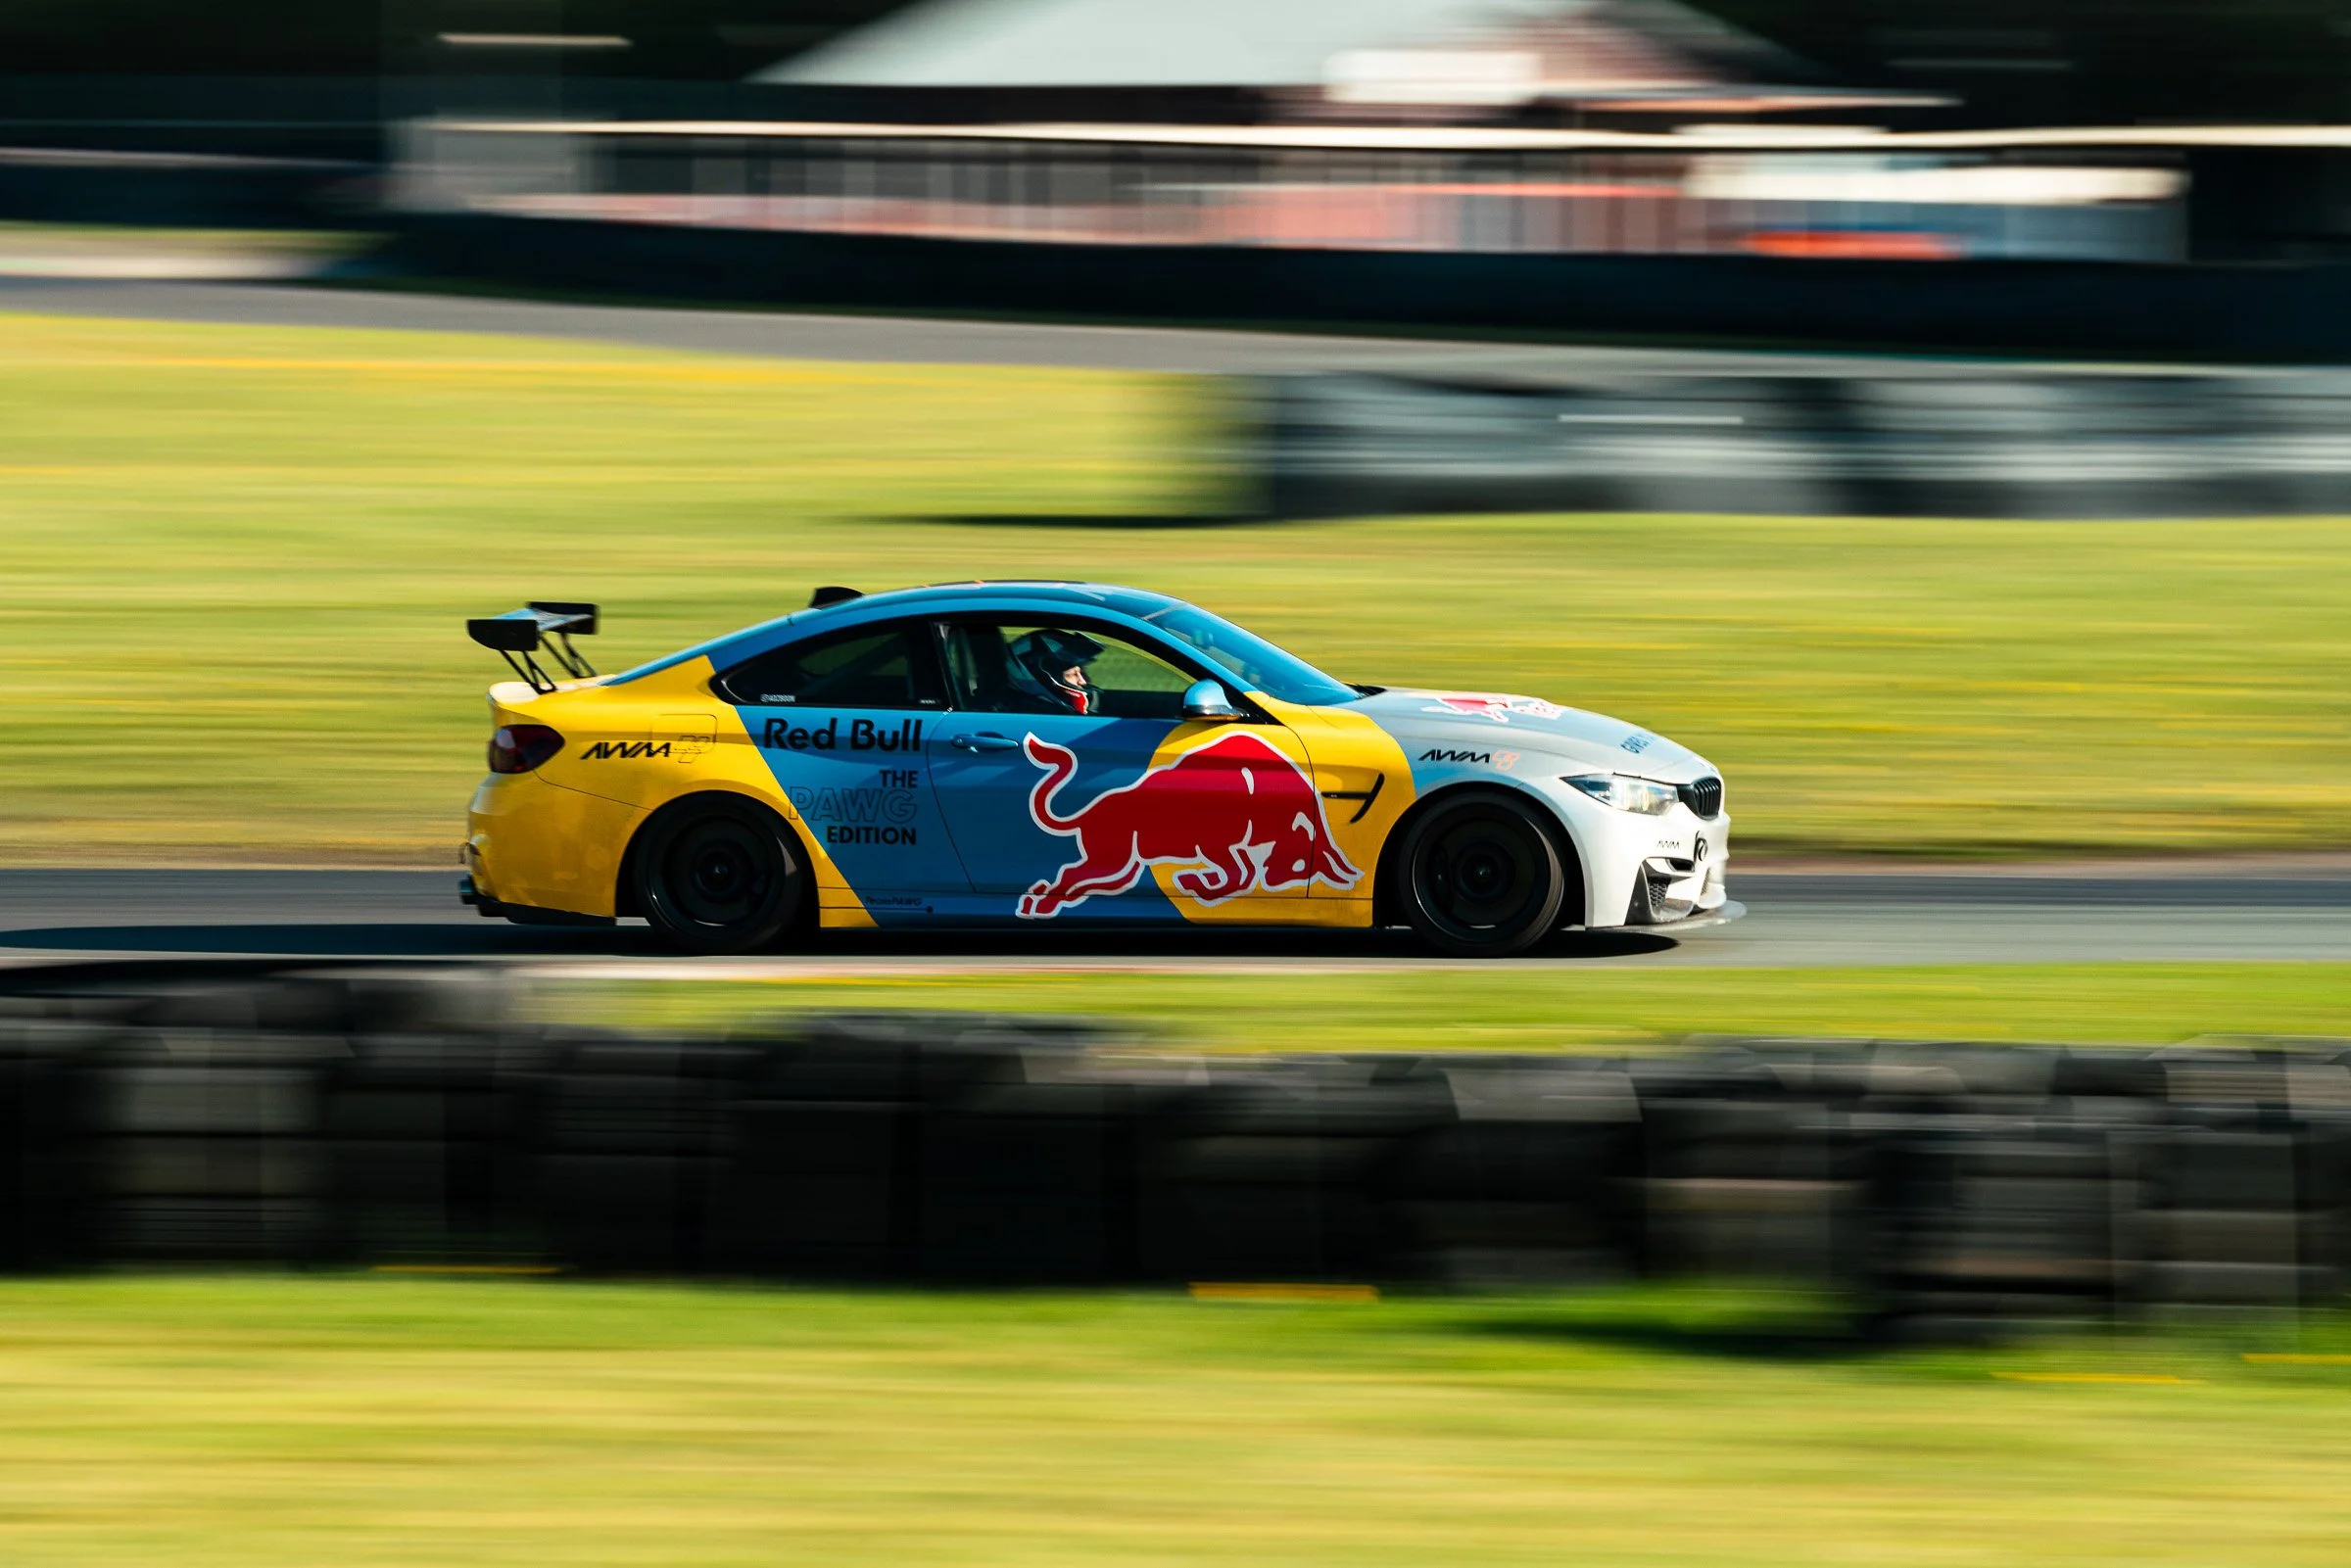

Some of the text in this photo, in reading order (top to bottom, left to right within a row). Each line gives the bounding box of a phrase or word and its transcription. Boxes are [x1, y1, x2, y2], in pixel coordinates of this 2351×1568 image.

[763, 717, 924, 752] Red Bull
[1418, 748, 1491, 764] AWM
[879, 770, 919, 789] THE
[789, 786, 917, 825] PAWG
[826, 826, 917, 846] EDITION
